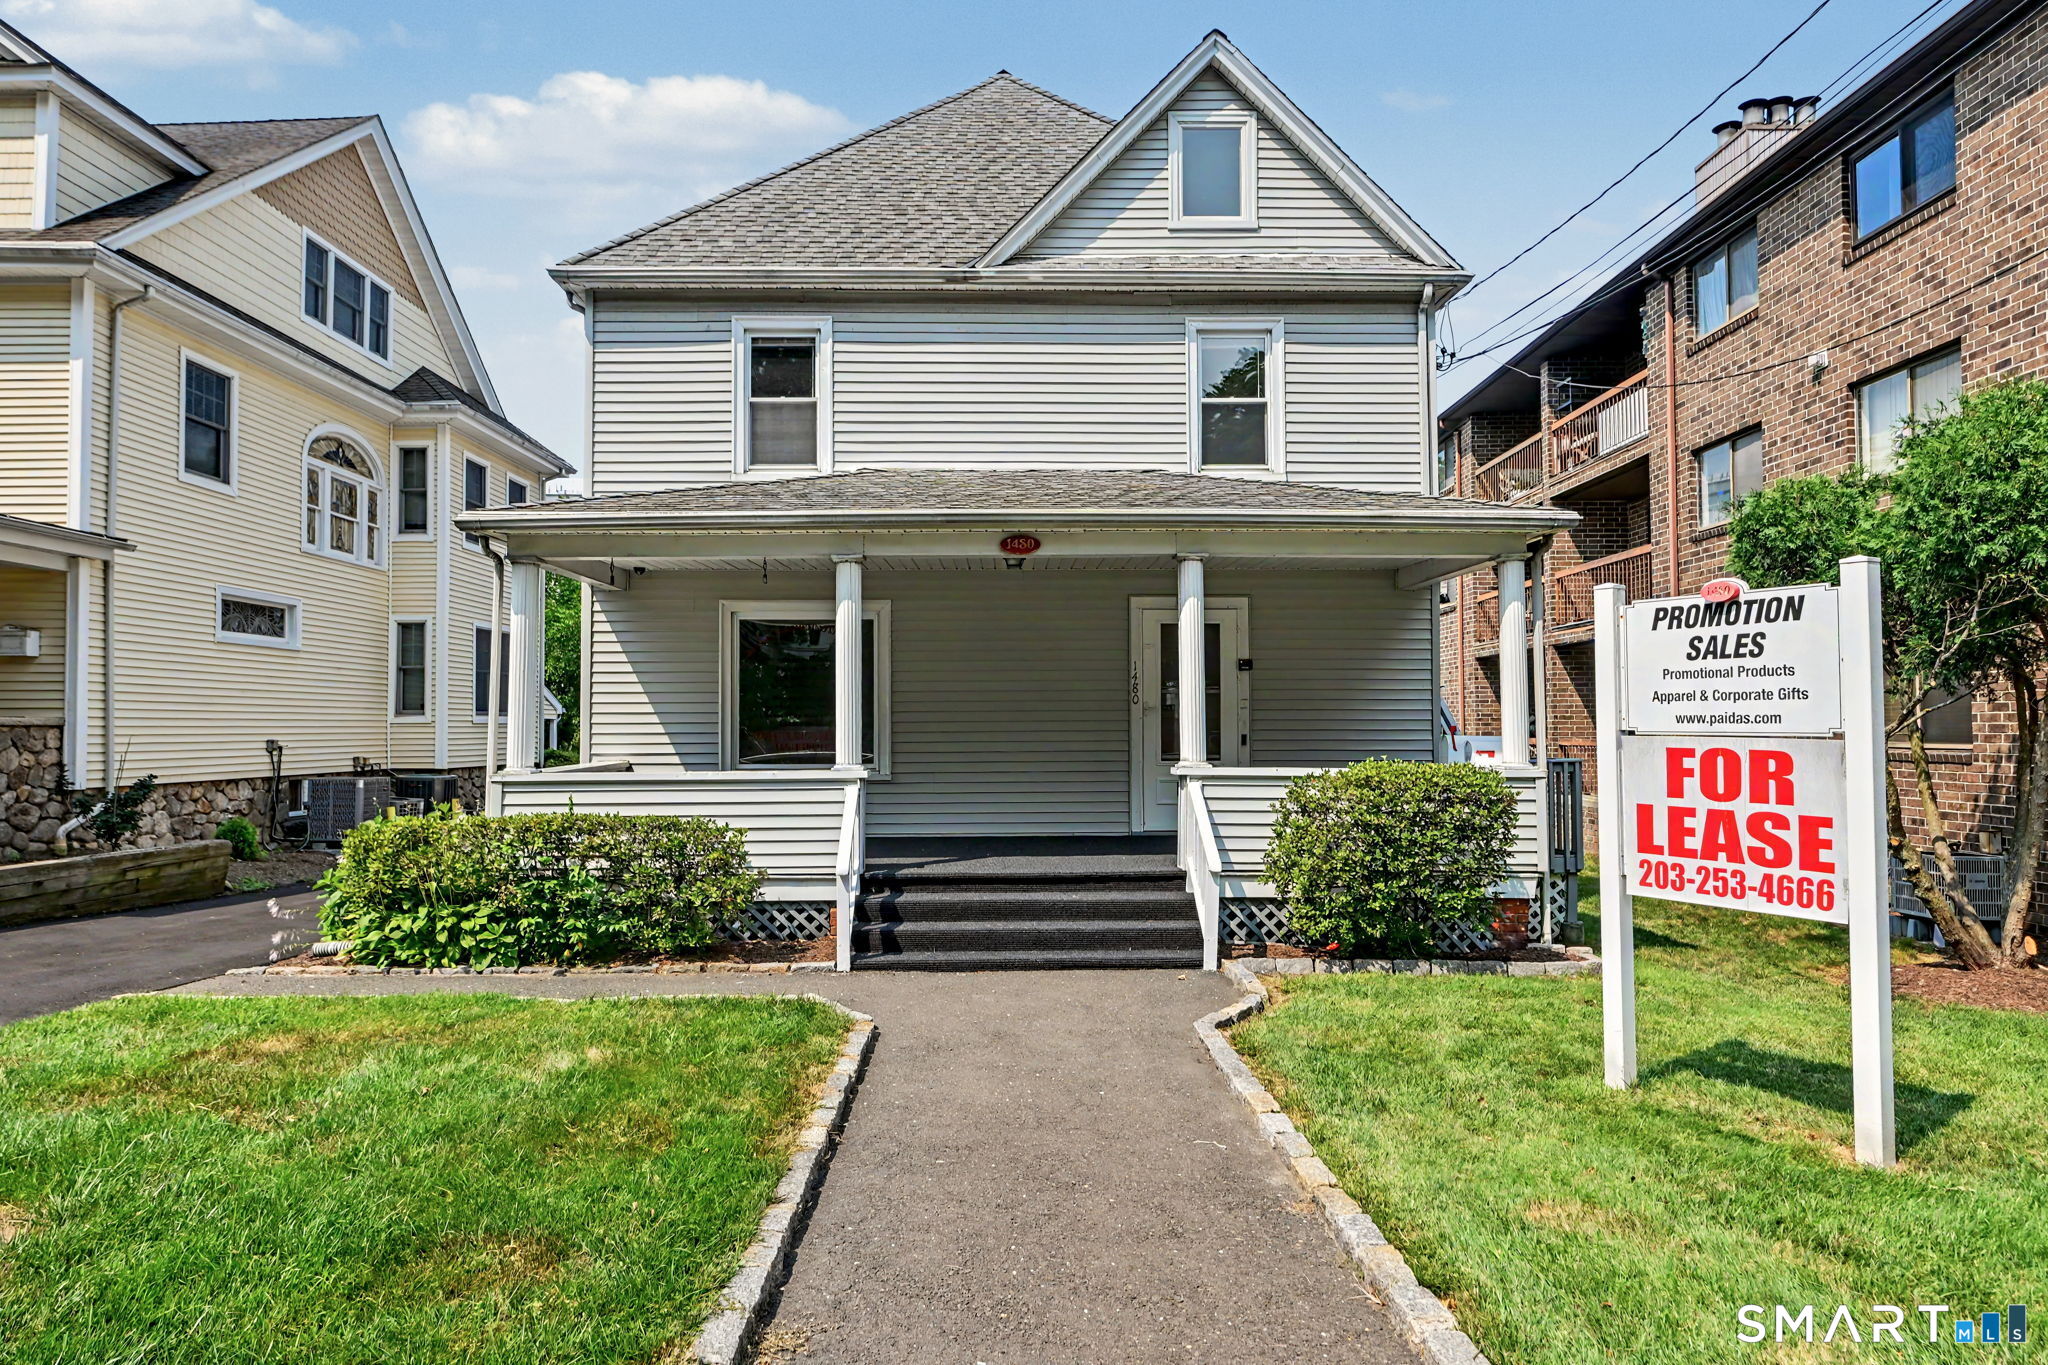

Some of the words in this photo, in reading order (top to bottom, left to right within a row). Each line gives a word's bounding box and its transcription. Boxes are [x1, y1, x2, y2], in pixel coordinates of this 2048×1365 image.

[1651, 594, 1806, 631] PROMOTION
[1686, 631, 1767, 661] SALES
[1662, 666, 1734, 681] Promotional
[1737, 664, 1796, 678] Products
[1652, 689, 1697, 705] Apparel
[1699, 690, 1709, 702] &
[1712, 688, 1774, 705] Corporate
[1778, 687, 1809, 701] Gifts
[1675, 711, 1782, 726] www.paidas.com
[1665, 747, 1795, 806] FOR
[1636, 803, 1836, 874] LEASE
[1638, 859, 1835, 912] 203-253-4666
